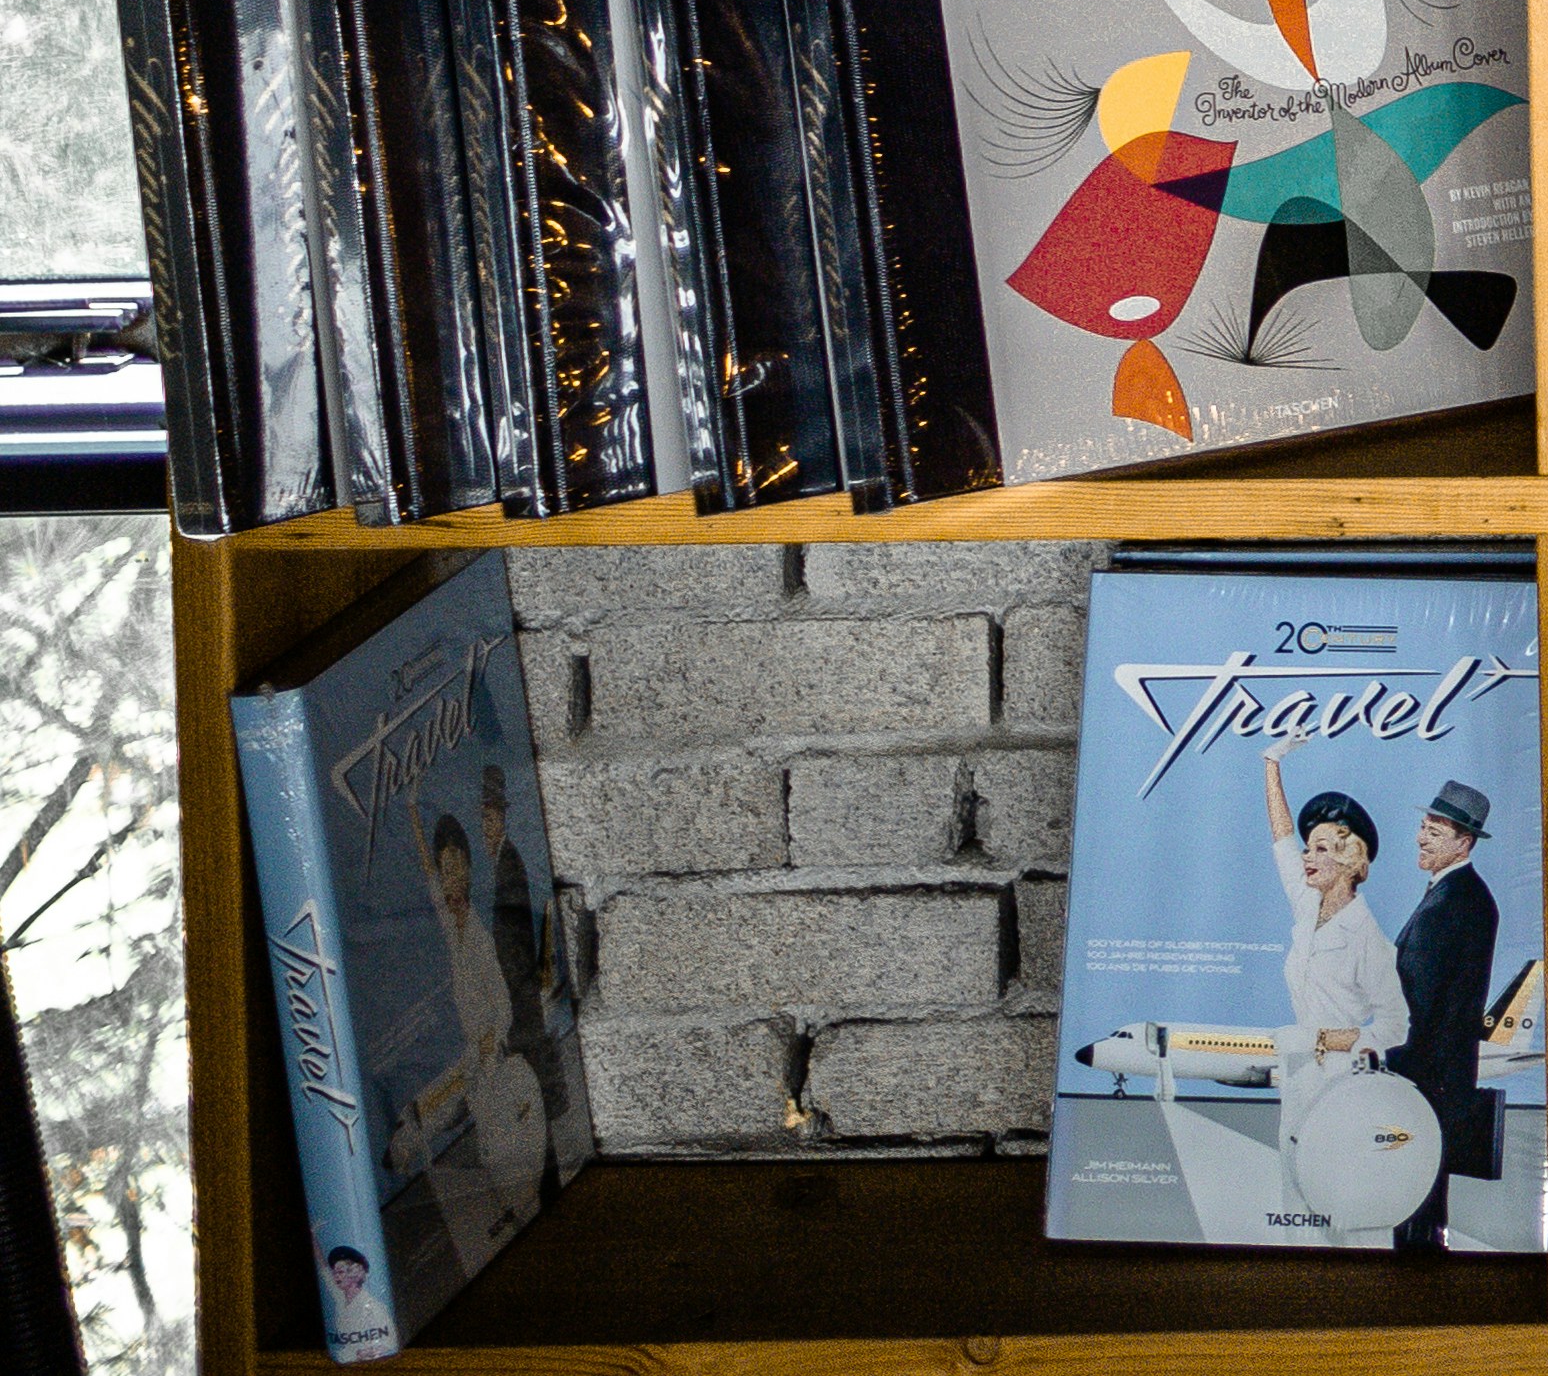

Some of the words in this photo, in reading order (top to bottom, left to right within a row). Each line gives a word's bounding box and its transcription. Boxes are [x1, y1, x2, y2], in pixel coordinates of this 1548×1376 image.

[1195, 92, 1278, 126] Inventor
[1312, 76, 1391, 111] Modern
[1391, 45, 1455, 92] Album
[1452, 37, 1511, 70] Cover
[1218, 75, 1255, 102] The
[1274, 621, 1328, 654] 20
[1114, 651, 1489, 800] Travel
[1071, 1172, 1130, 1184] ALLISON
[1131, 1172, 1178, 1184] SILVER
[1110, 1159, 1171, 1172] HEIMANN
[1265, 1213, 1331, 1228] TASCHEN
